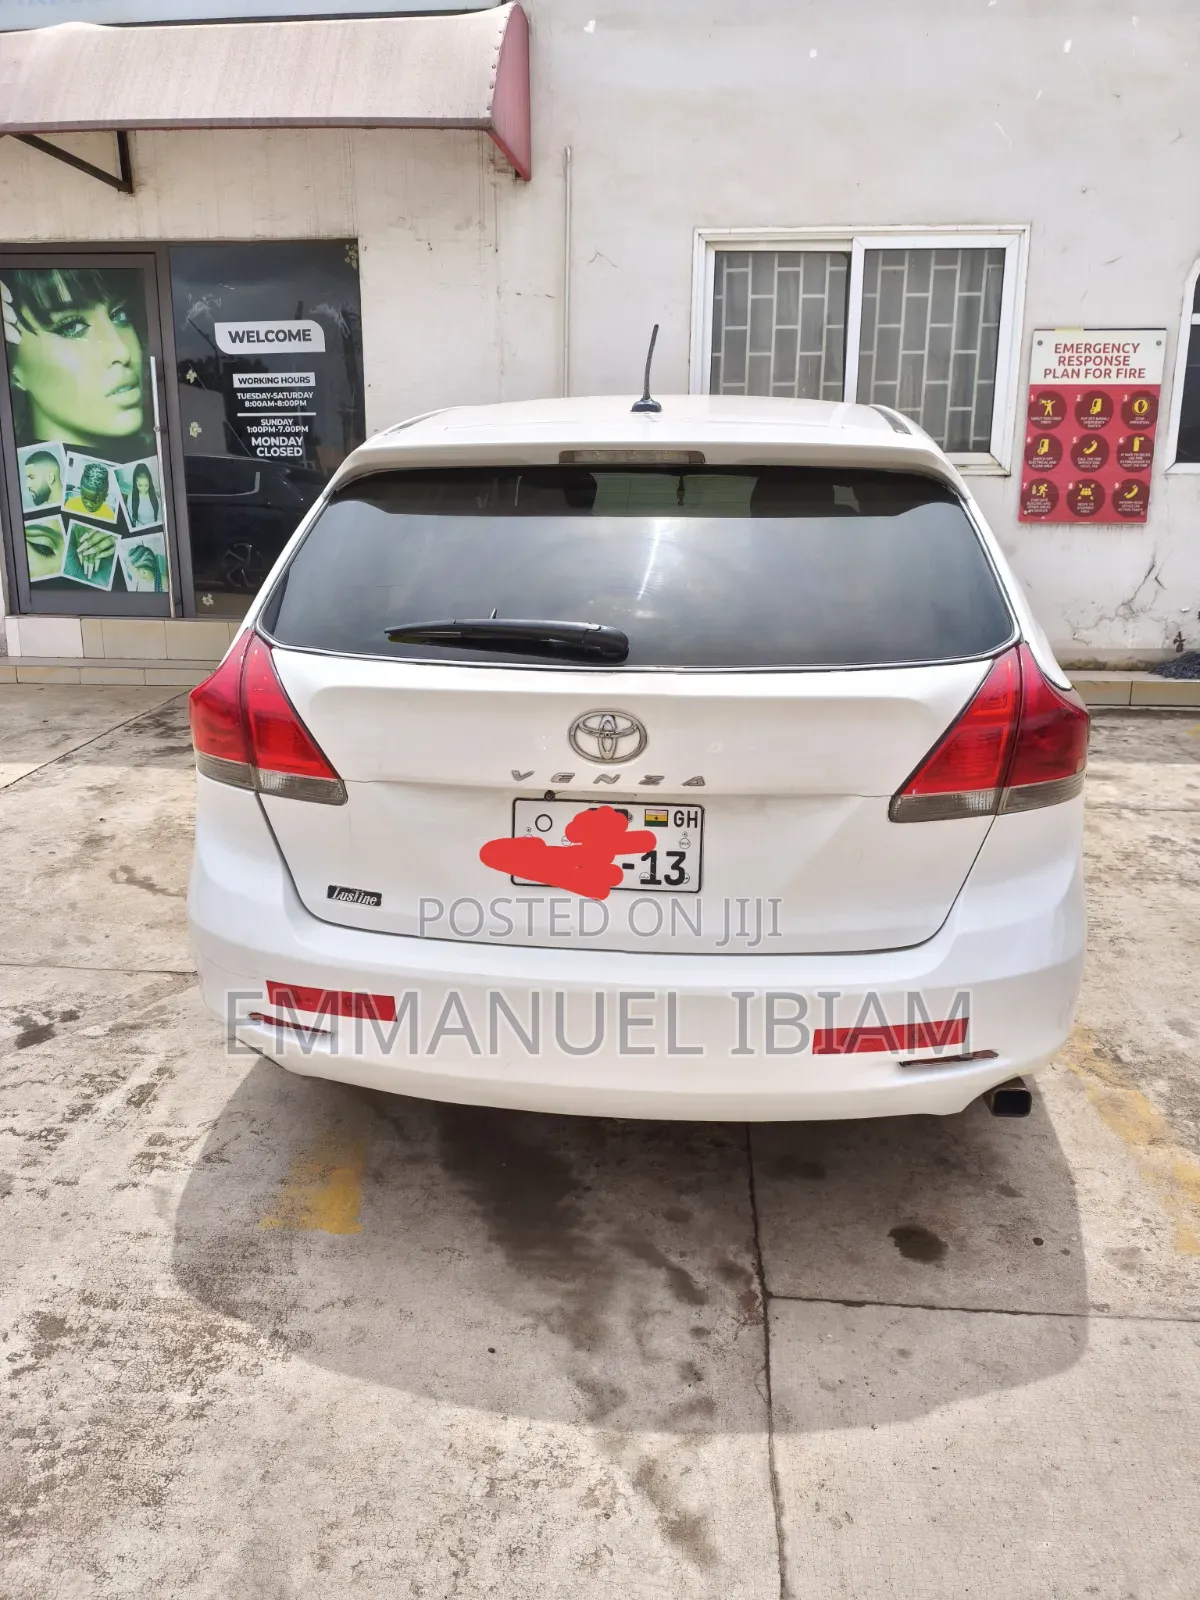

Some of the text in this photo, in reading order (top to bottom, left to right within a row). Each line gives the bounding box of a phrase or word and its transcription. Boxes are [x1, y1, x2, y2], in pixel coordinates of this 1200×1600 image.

[228, 329, 312, 344] WELCOME
[1054, 342, 1141, 354] EMERGENCY
[1057, 355, 1131, 367] RESPONSE
[1043, 367, 1146, 379] PLAN FOR FIRE
[238, 376, 311, 385] WORKING HOURS
[237, 392, 314, 400] TUESDAY-SATURDAY
[244, 400, 307, 408] 8:00AM-8:00PM
[260, 418, 294, 426] SUNDAY
[251, 436, 304, 446] MONDAY
[256, 447, 303, 457] CLOSED
[511, 769, 706, 787] VENZA
[673, 810, 698, 828] GH
